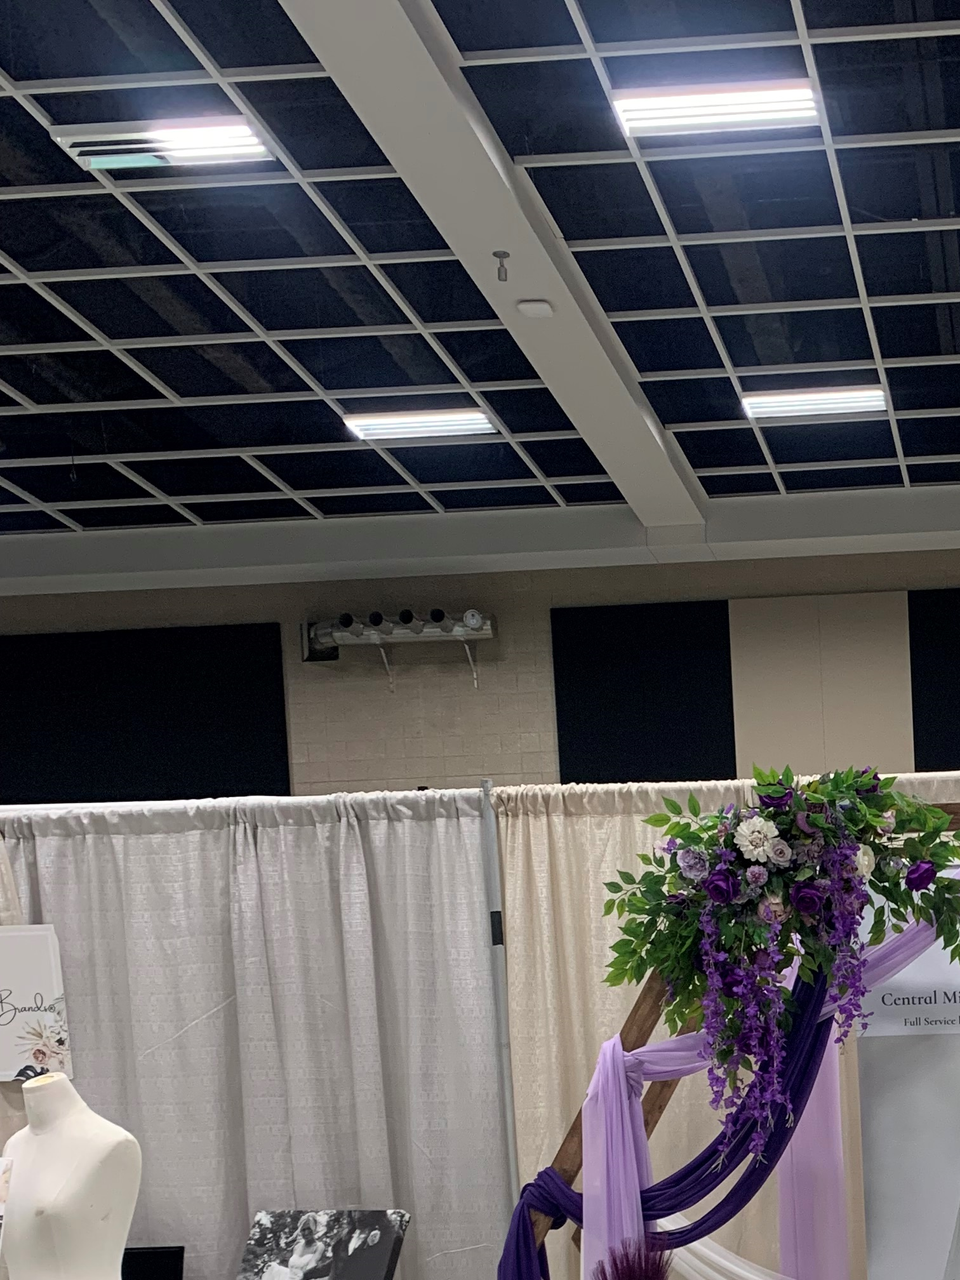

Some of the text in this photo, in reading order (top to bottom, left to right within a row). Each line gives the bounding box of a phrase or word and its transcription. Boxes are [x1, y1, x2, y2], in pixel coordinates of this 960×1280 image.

[881, 990, 937, 1006] Central
[904, 1017, 921, 1027] Full
[924, 1016, 956, 1026] Service
